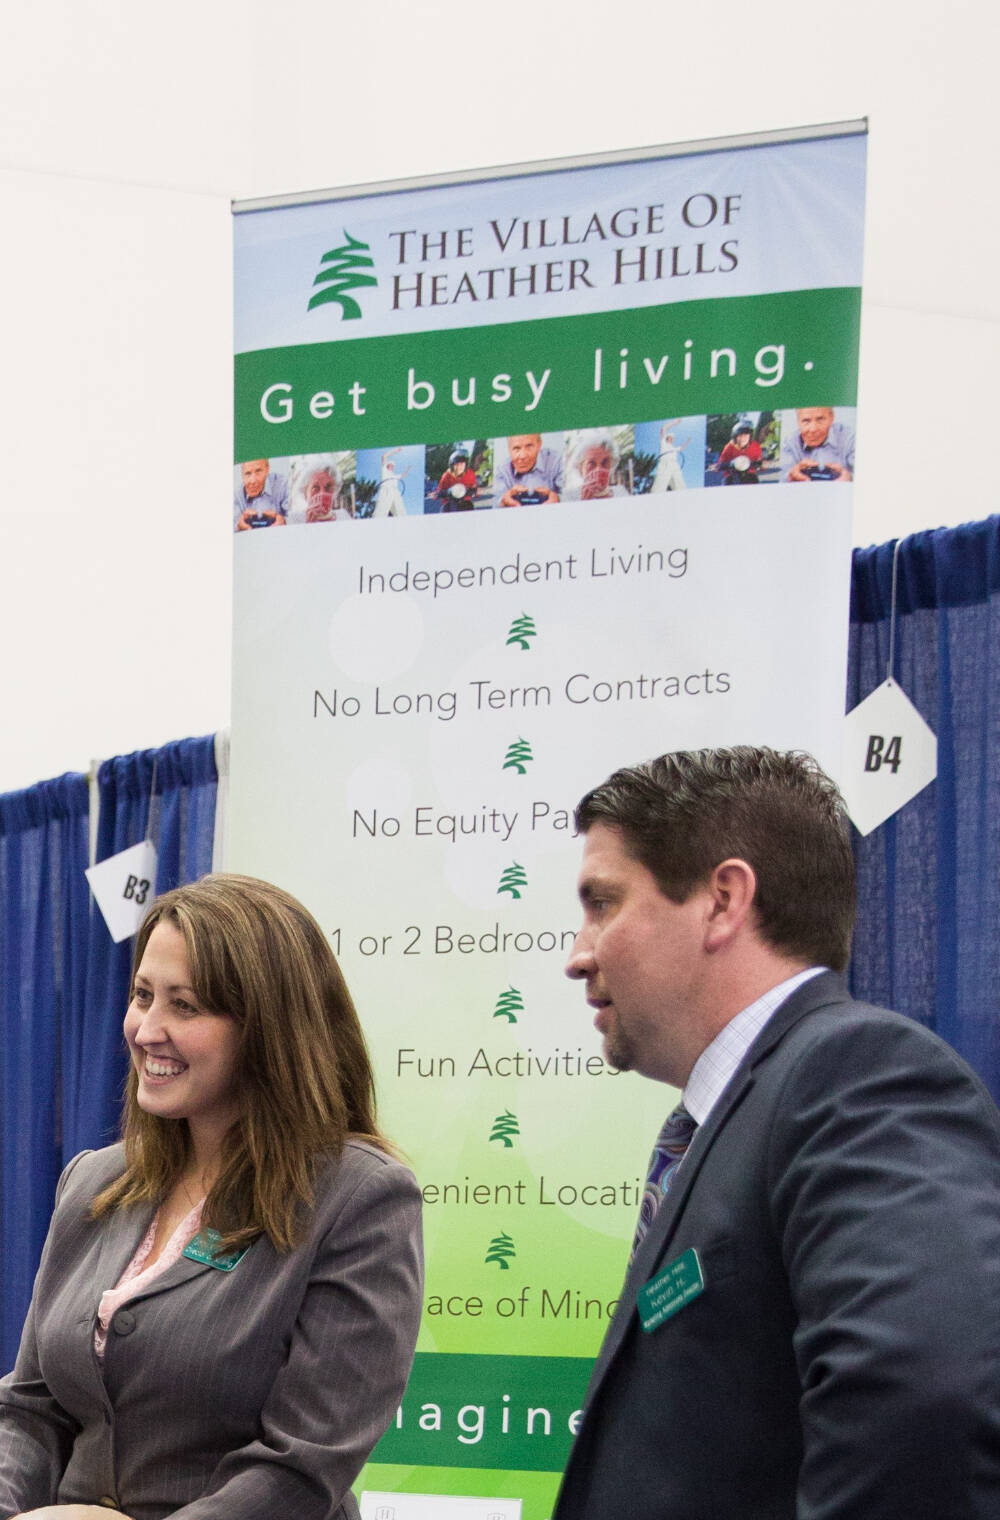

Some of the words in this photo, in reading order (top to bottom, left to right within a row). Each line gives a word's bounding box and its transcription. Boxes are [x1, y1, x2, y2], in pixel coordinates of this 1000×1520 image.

[388, 226, 474, 266] THE
[490, 202, 665, 251] VILLAGE
[681, 191, 744, 229] OF
[390, 256, 596, 312] HEATHER
[613, 239, 739, 287] HILLS
[260, 380, 367, 424] Get
[407, 367, 552, 412] busy
[593, 339, 815, 391] living.
[358, 552, 578, 600] Independent
[590, 544, 690, 577] Living
[312, 689, 361, 719] No
[374, 686, 458, 722] Long
[470, 680, 552, 711] Term
[565, 667, 731, 706] Contracts
[864, 735, 902, 774] B4
[352, 809, 401, 839] No
[414, 805, 518, 843] Equity
[123, 874, 150, 904] B3
[332, 927, 342, 956] 1
[359, 935, 392, 956] or
[403, 926, 421, 955] 2
[397, 1048, 455, 1077] Fun
[496, 1286, 531, 1317] of
